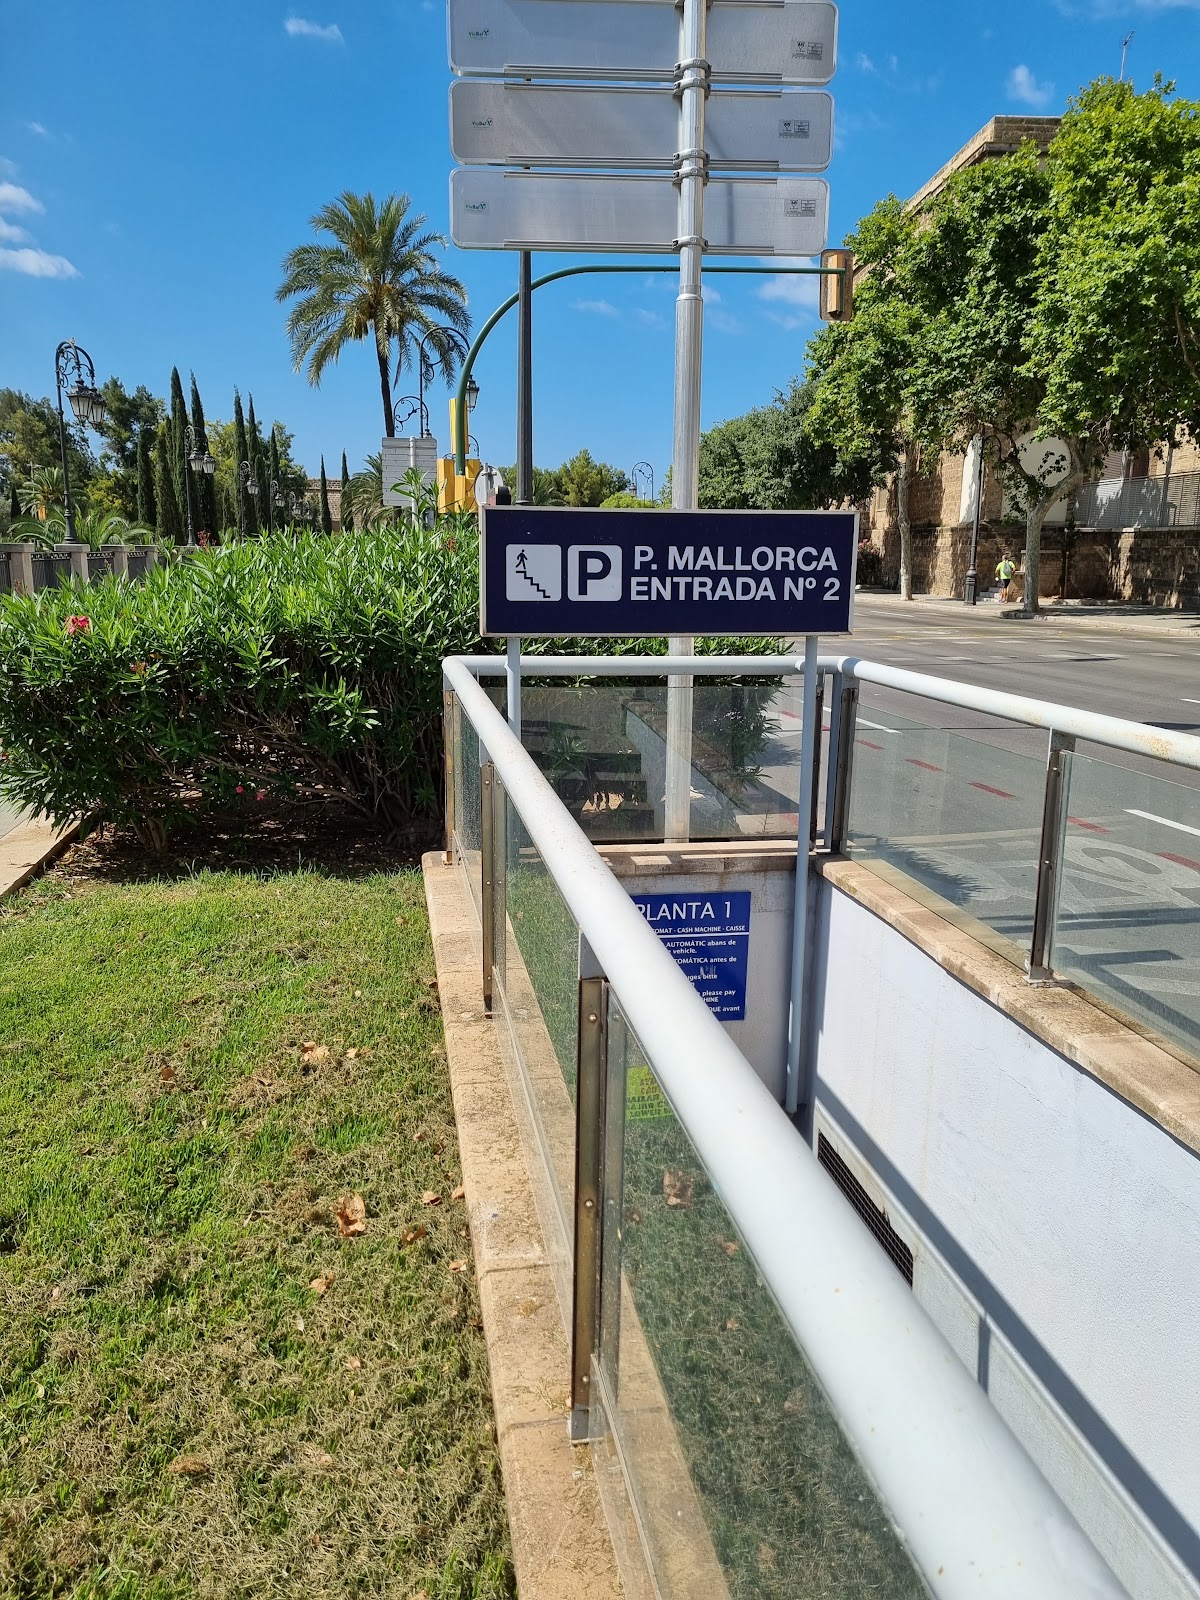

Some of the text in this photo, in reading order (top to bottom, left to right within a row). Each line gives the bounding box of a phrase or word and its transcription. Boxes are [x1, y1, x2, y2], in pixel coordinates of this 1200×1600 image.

[634, 545, 838, 571] P. MALLORCA
[577, 550, 612, 596] P
[630, 576, 776, 601] ENTRADA
[823, 577, 841, 601] 2
[724, 901, 731, 918] 1
